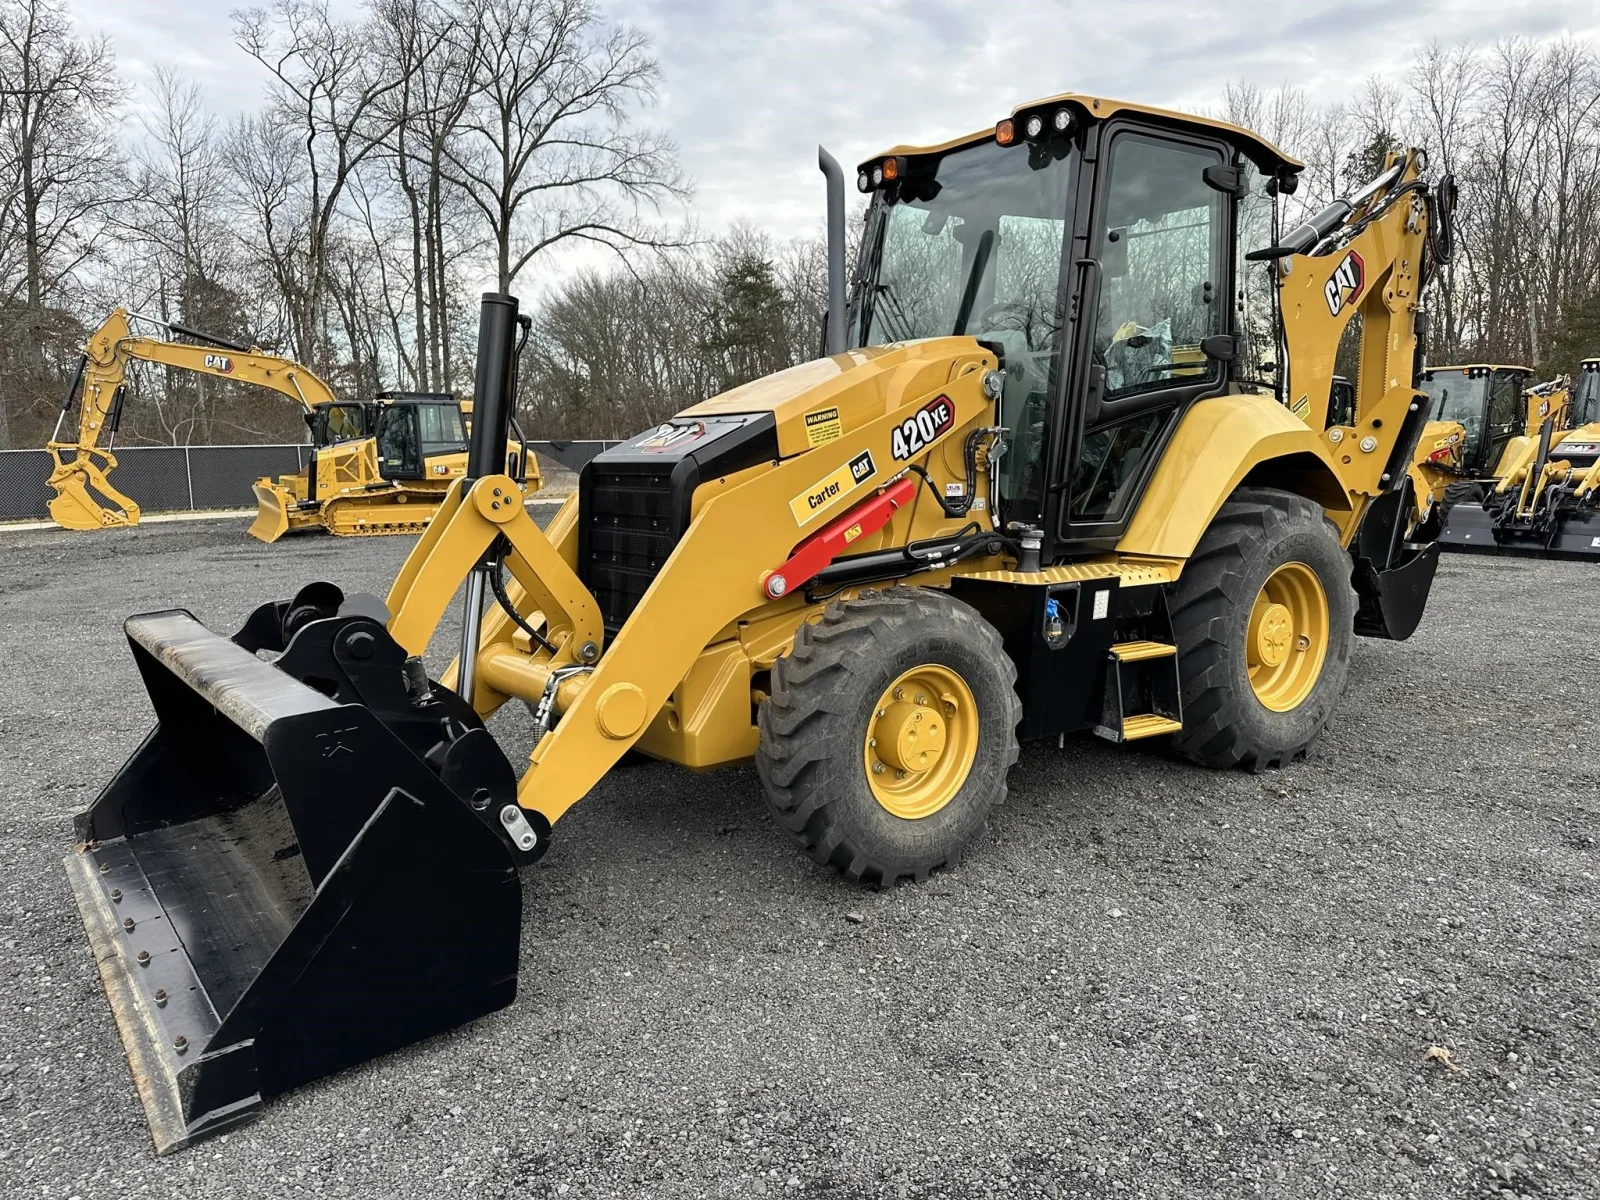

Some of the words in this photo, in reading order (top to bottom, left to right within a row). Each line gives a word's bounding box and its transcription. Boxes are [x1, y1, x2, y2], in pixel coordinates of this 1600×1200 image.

[1325, 254, 1357, 315] CAT
[204, 354, 228, 370] CAT
[806, 410, 838, 425] WARNING
[433, 465, 446, 474] CAT
[808, 481, 840, 509] Carter
[852, 457, 870, 479] CAT
